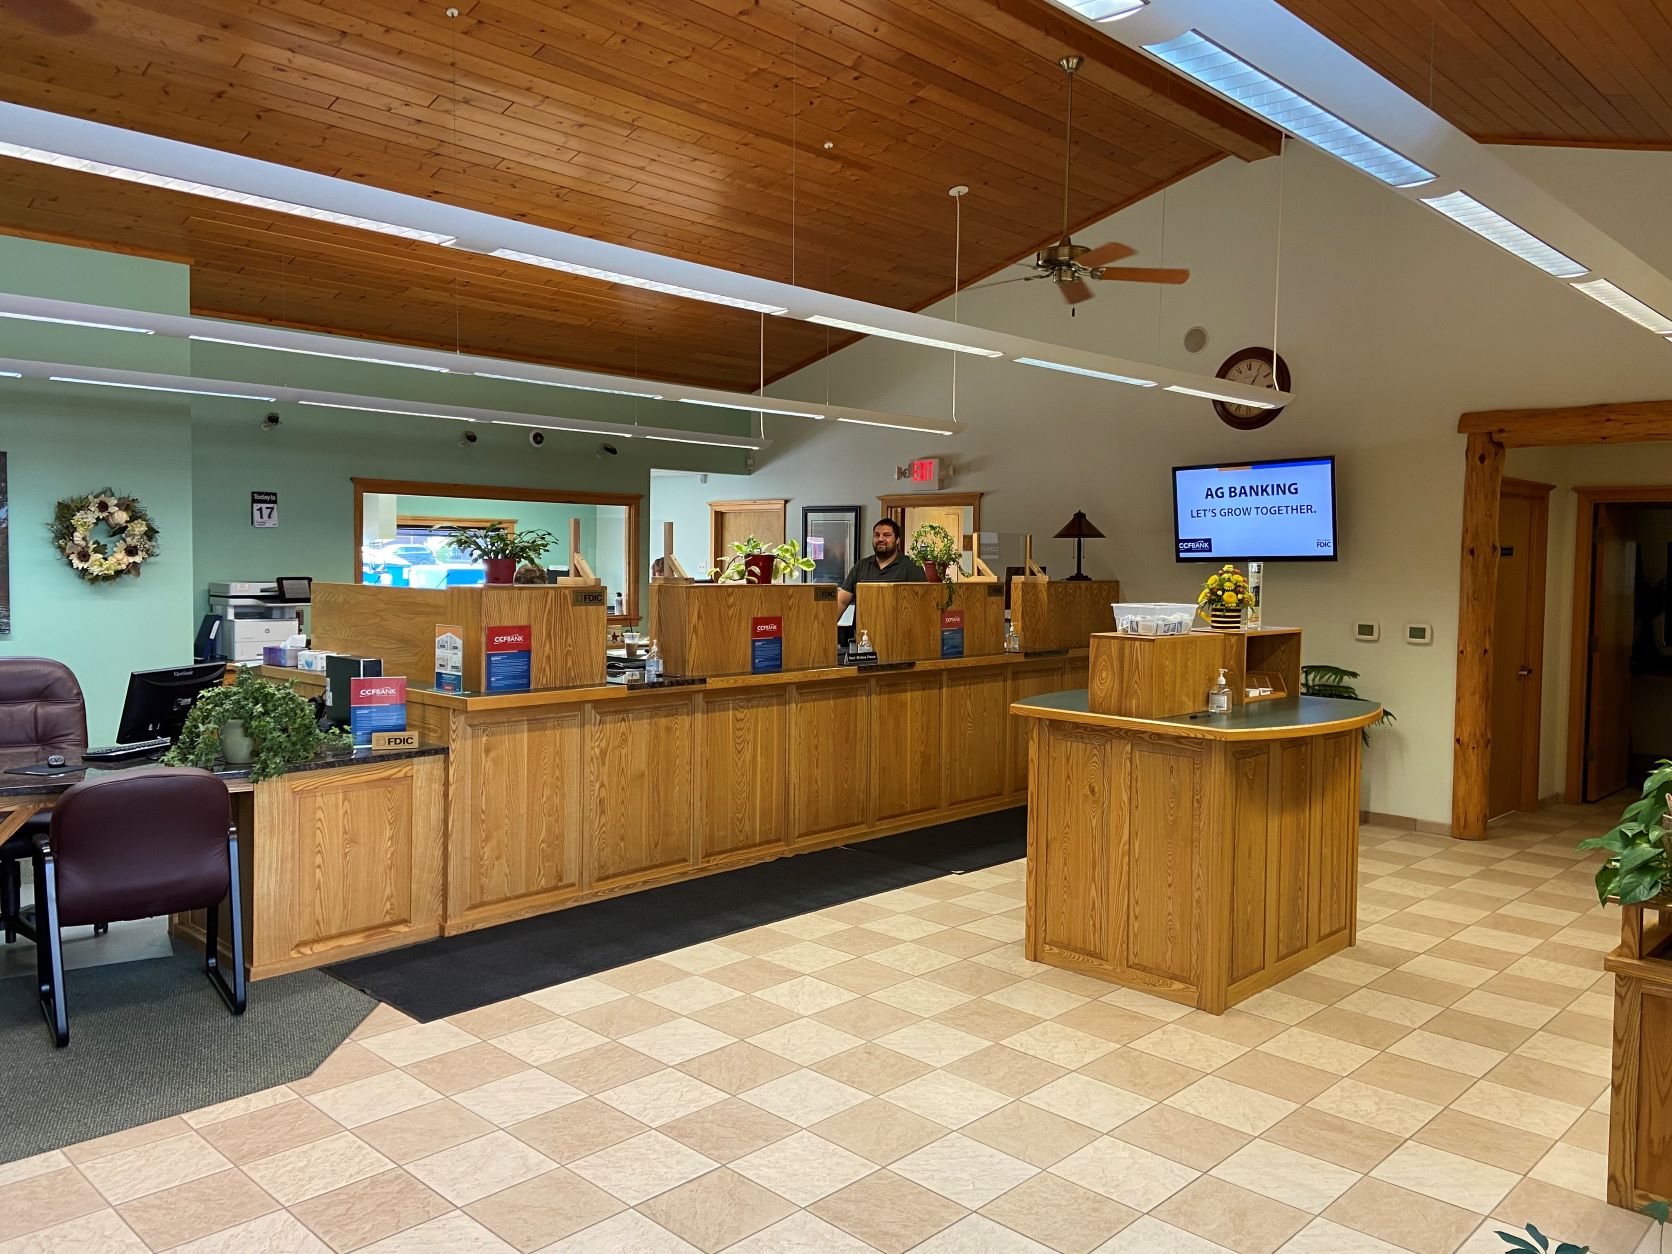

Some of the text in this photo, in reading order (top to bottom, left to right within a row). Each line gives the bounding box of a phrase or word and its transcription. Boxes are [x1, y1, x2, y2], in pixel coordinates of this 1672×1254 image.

[912, 461, 934, 481] EXIT
[1204, 482, 1299, 499] AG BANKING
[256, 506, 275, 519] 17
[1190, 504, 1317, 518] LET'S GROW TOGETHER.
[1178, 540, 1209, 549] CCFBANK
[583, 594, 602, 602] FDIC
[493, 634, 524, 644] CCFBANK
[359, 687, 397, 697] CCFBANK
[387, 736, 414, 746] FDIC
